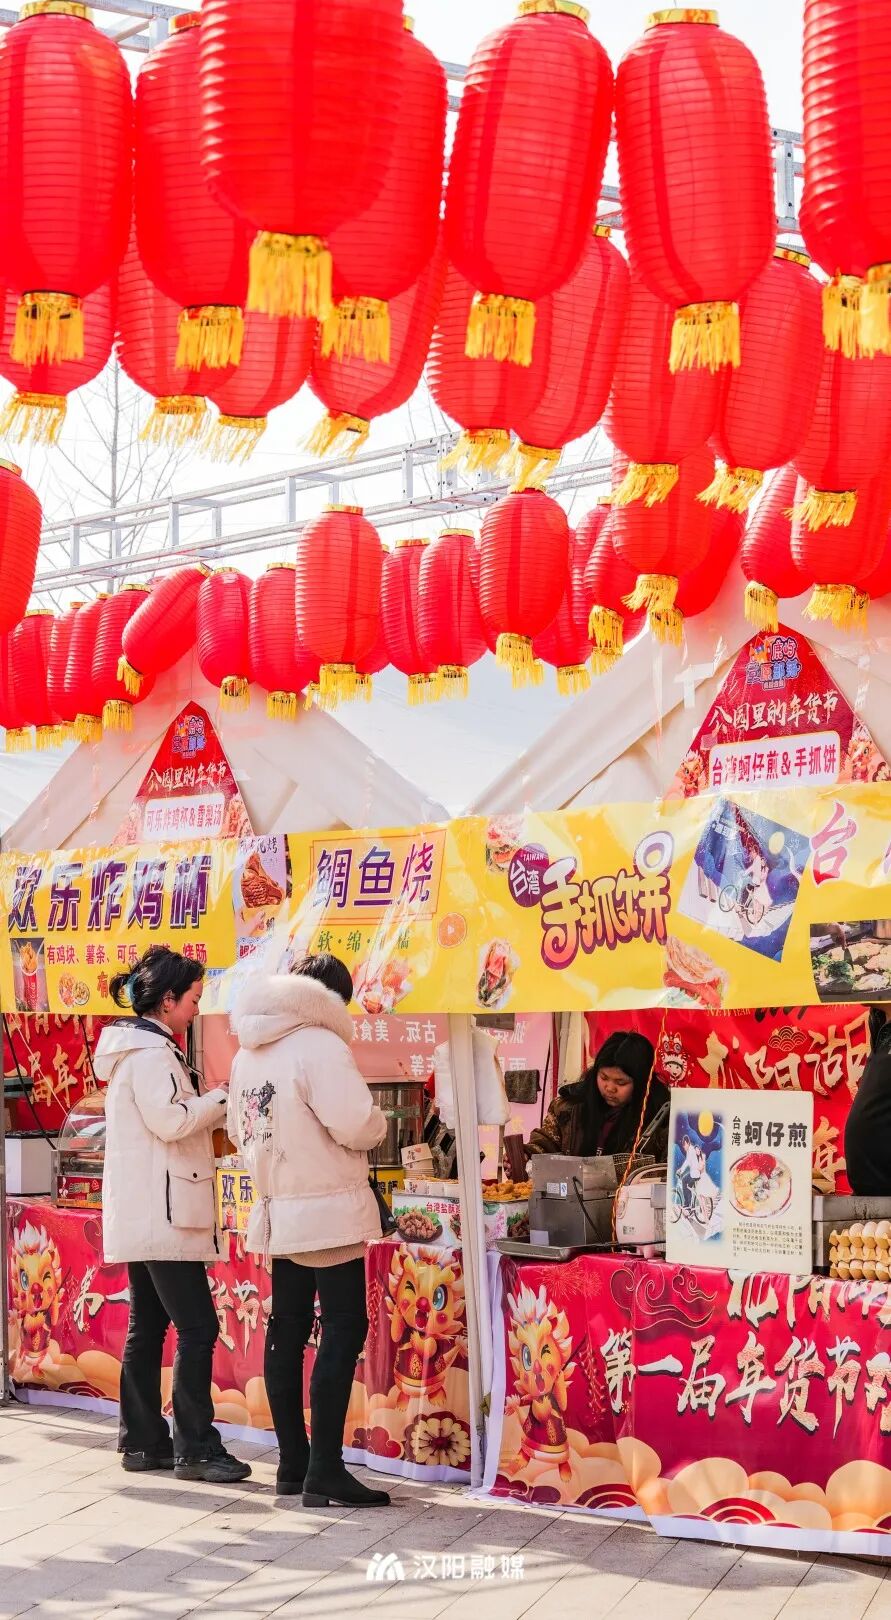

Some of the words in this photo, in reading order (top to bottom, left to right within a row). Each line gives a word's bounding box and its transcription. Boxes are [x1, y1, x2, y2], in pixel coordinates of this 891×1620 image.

[708, 690, 839, 735] 公园里的年货节
[711, 744, 837, 786] 台湾蚵仔煎&手抓饼
[314, 842, 434, 908] 鲷鱼烧
[510, 860, 541, 897] 台湾
[541, 831, 674, 970] 手抓饼
[731, 1116, 741, 1146] 台湾
[745, 1121, 808, 1148] 蚵仔煎
[222, 1174, 254, 1203] 欢乐
